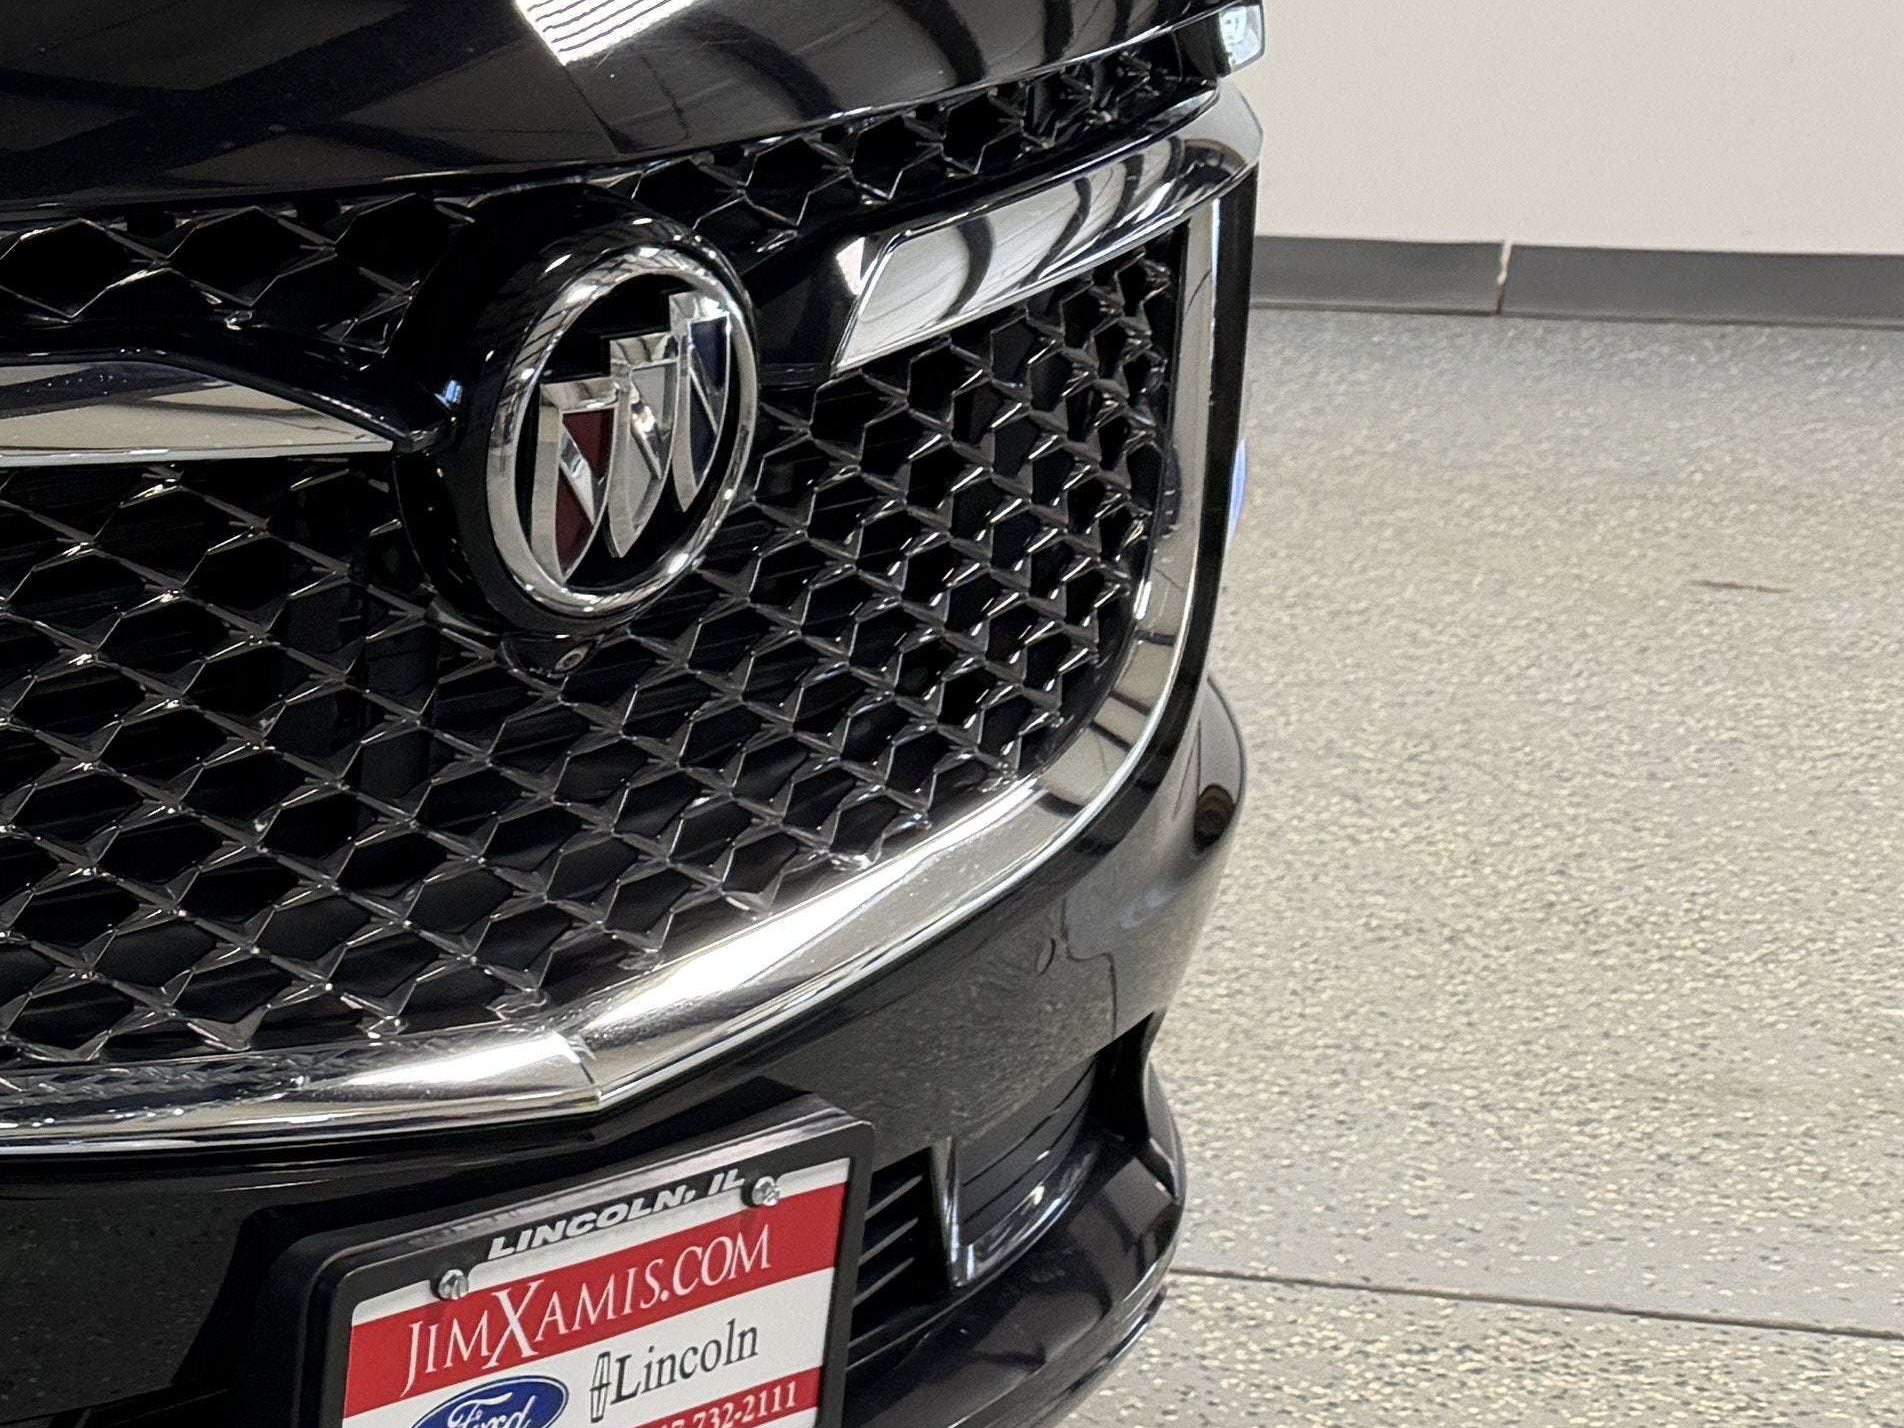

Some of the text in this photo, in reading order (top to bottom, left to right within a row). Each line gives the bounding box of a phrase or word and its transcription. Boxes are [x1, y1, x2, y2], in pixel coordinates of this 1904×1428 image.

[488, 1169, 745, 1260] LINCOLN, IL
[400, 1224, 771, 1398] JIMXAMIS.COM
[610, 1318, 758, 1405] Lincoln
